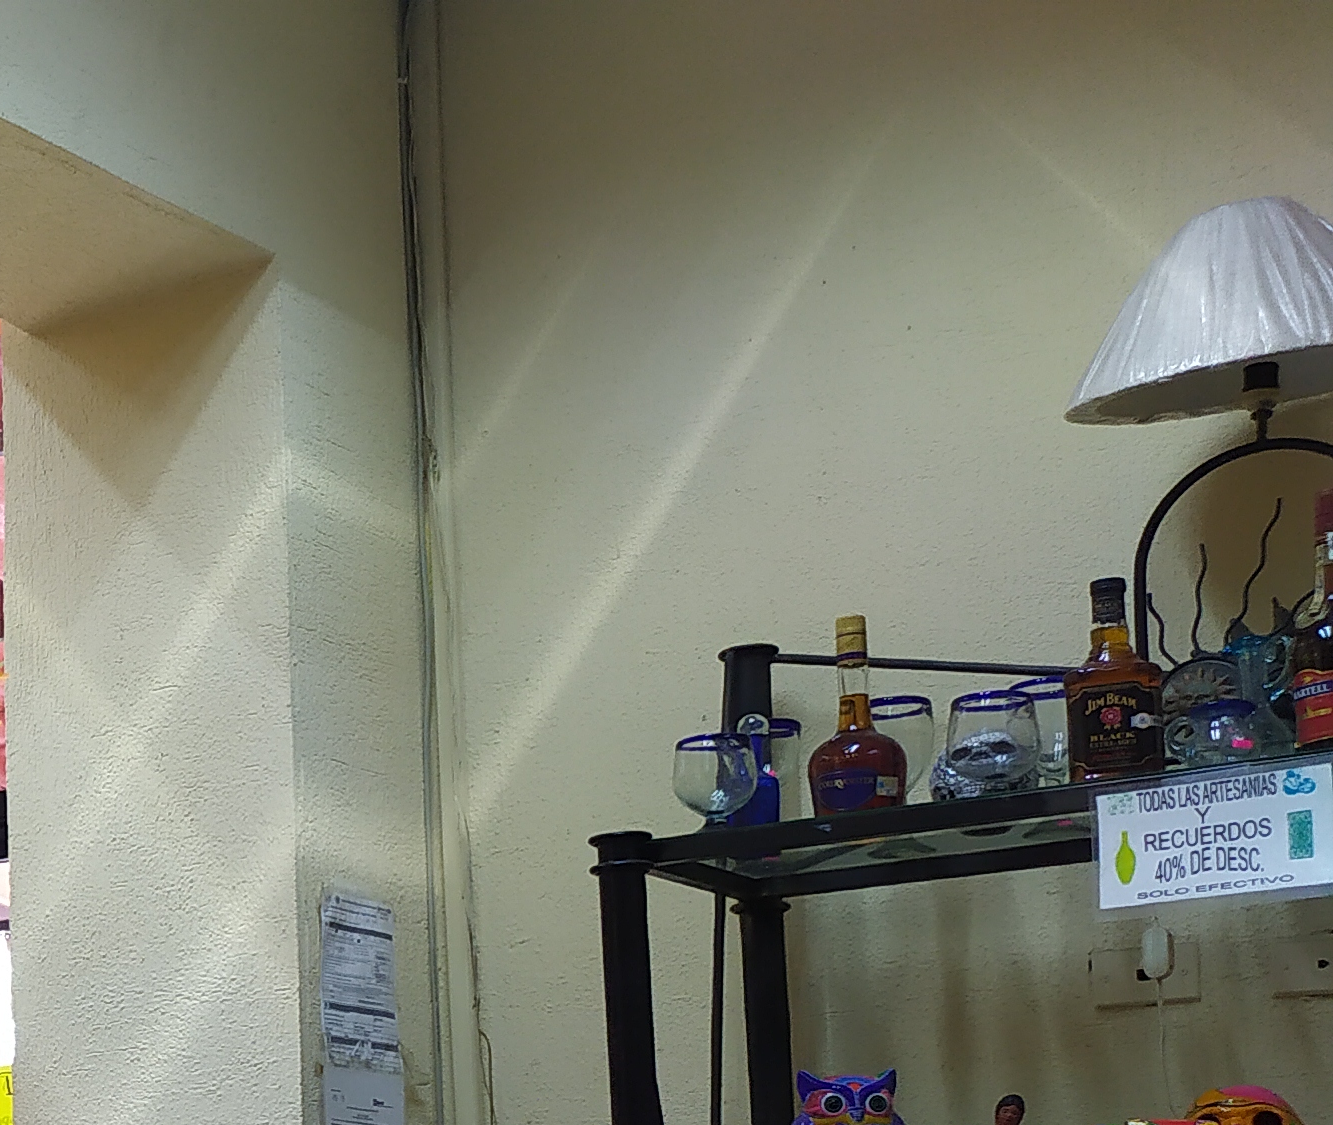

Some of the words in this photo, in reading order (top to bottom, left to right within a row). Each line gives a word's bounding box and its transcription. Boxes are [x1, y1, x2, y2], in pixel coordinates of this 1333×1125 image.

[1085, 697, 1104, 715] JIM
[1107, 693, 1137, 709] BEAM
[1136, 791, 1176, 813] TODAS
[1178, 784, 1200, 808] LAS
[1202, 773, 1277, 805] ARTESANIAS
[1195, 807, 1211, 824] Y
[1144, 818, 1272, 852] RECUERDOS
[1155, 854, 1186, 883] 40%
[1190, 846, 1212, 875] DE
[1216, 846, 1265, 873] DESC.
[1137, 887, 1189, 900] SOLO
[1195, 874, 1295, 893] EFECTIVO
